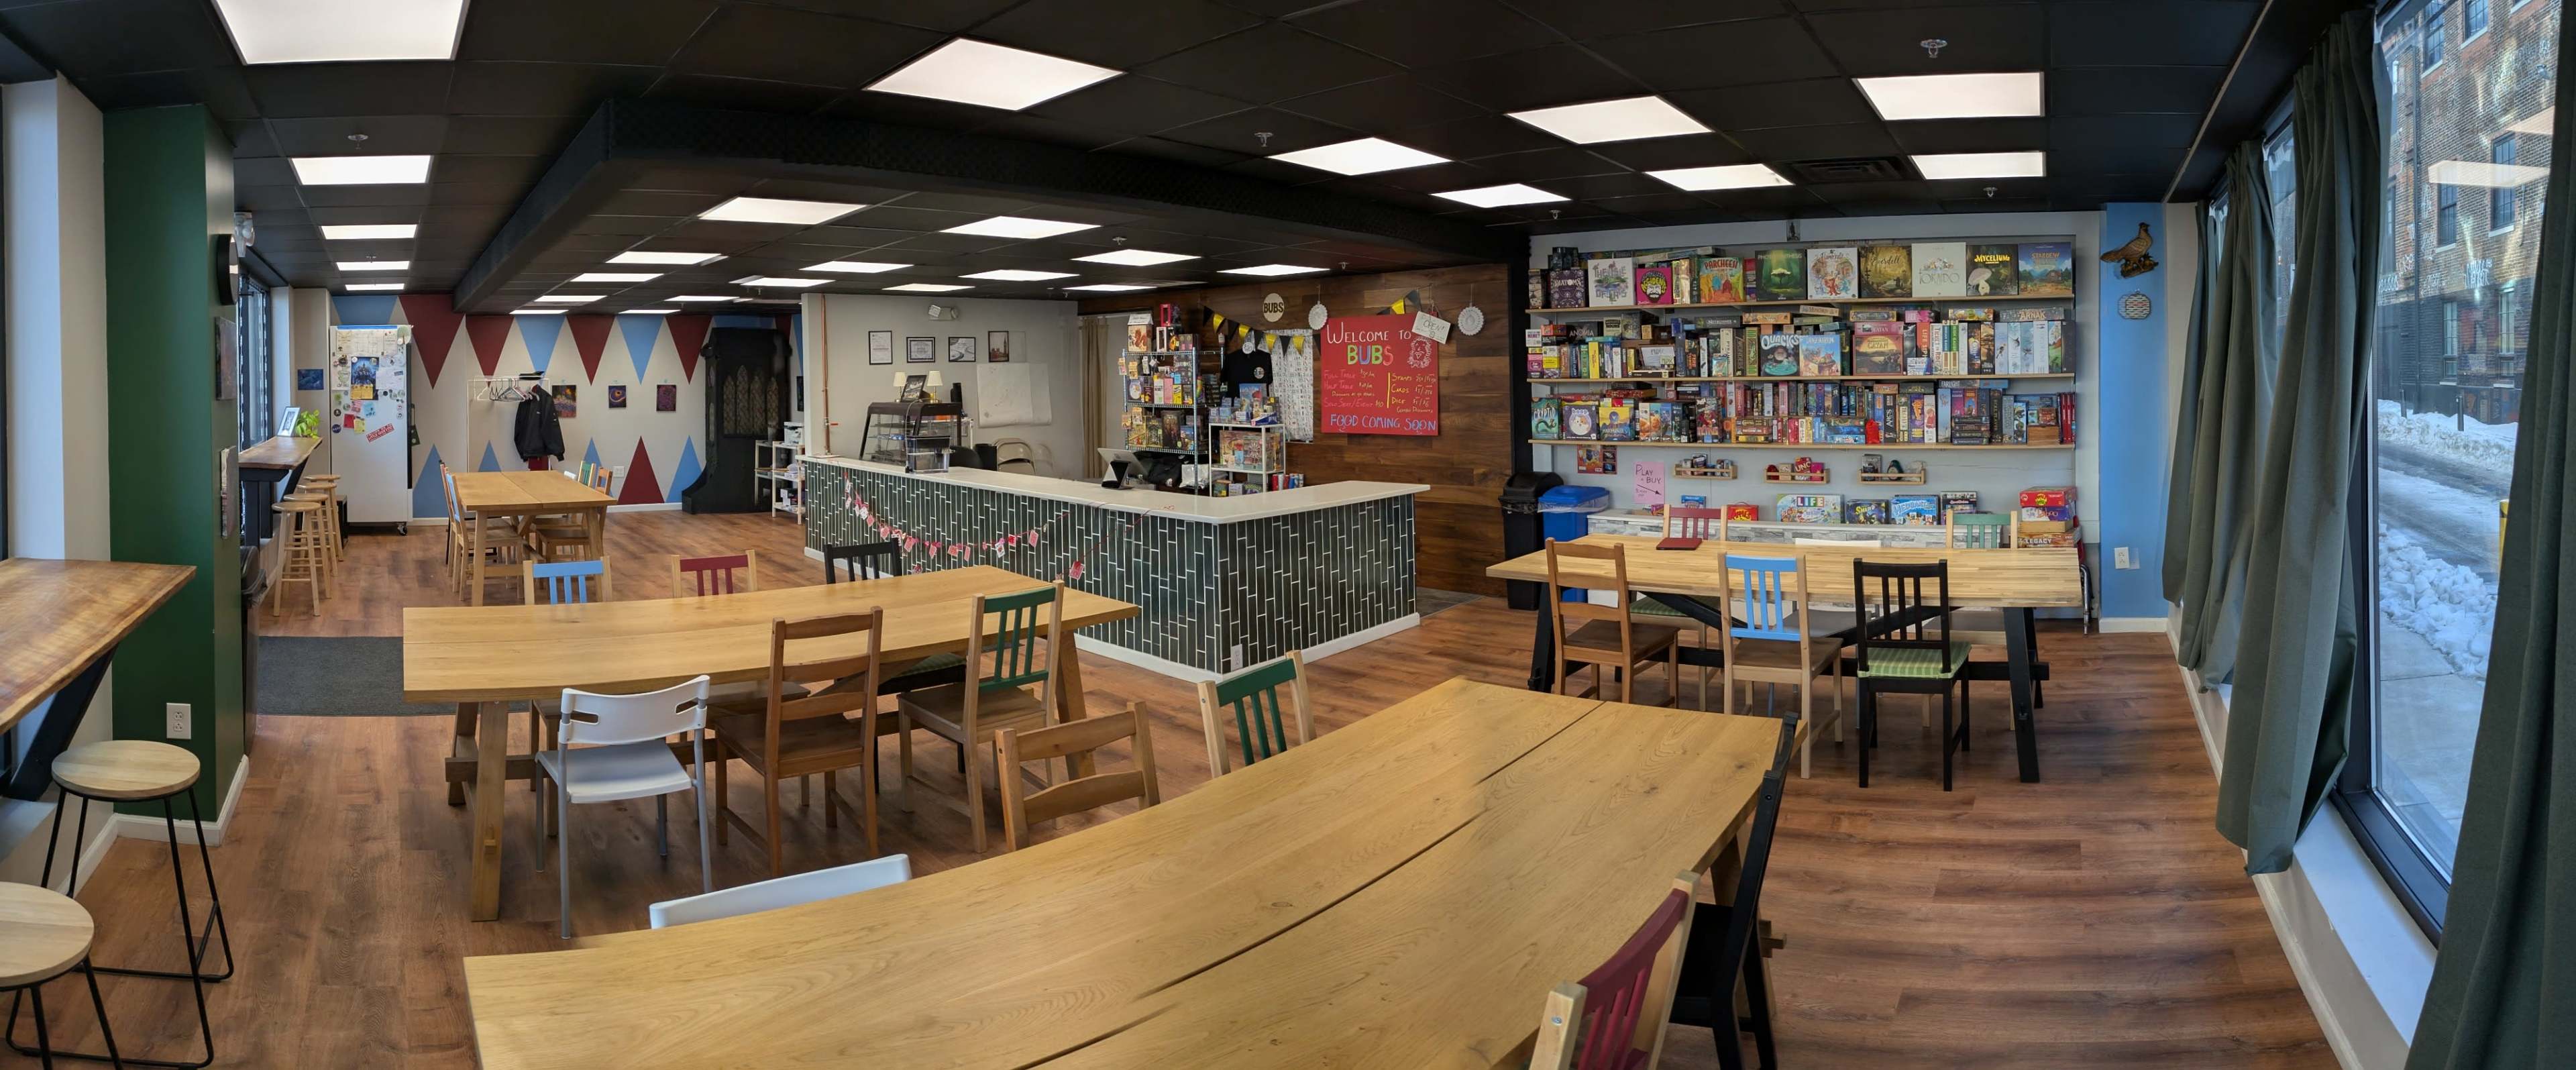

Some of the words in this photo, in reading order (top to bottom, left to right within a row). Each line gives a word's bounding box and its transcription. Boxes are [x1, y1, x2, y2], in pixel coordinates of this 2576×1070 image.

[1974, 254, 2010, 262] MYCELIUM
[1704, 259, 1739, 270] PARCHEESI
[1264, 302, 1284, 313] BUBS
[2020, 311, 2045, 320] ARNAK
[1327, 321, 1389, 343] WELCOME
[1399, 329, 1411, 340] TO
[1347, 344, 1393, 366] BUBS
[1534, 407, 1556, 419] CRYPTID
[1330, 413, 1358, 427] FOOD
[1362, 415, 1400, 428] COMING
[1403, 418, 1436, 431] SOON
[1635, 464, 1653, 476] PLAY
[1798, 496, 1824, 506] LIFE
